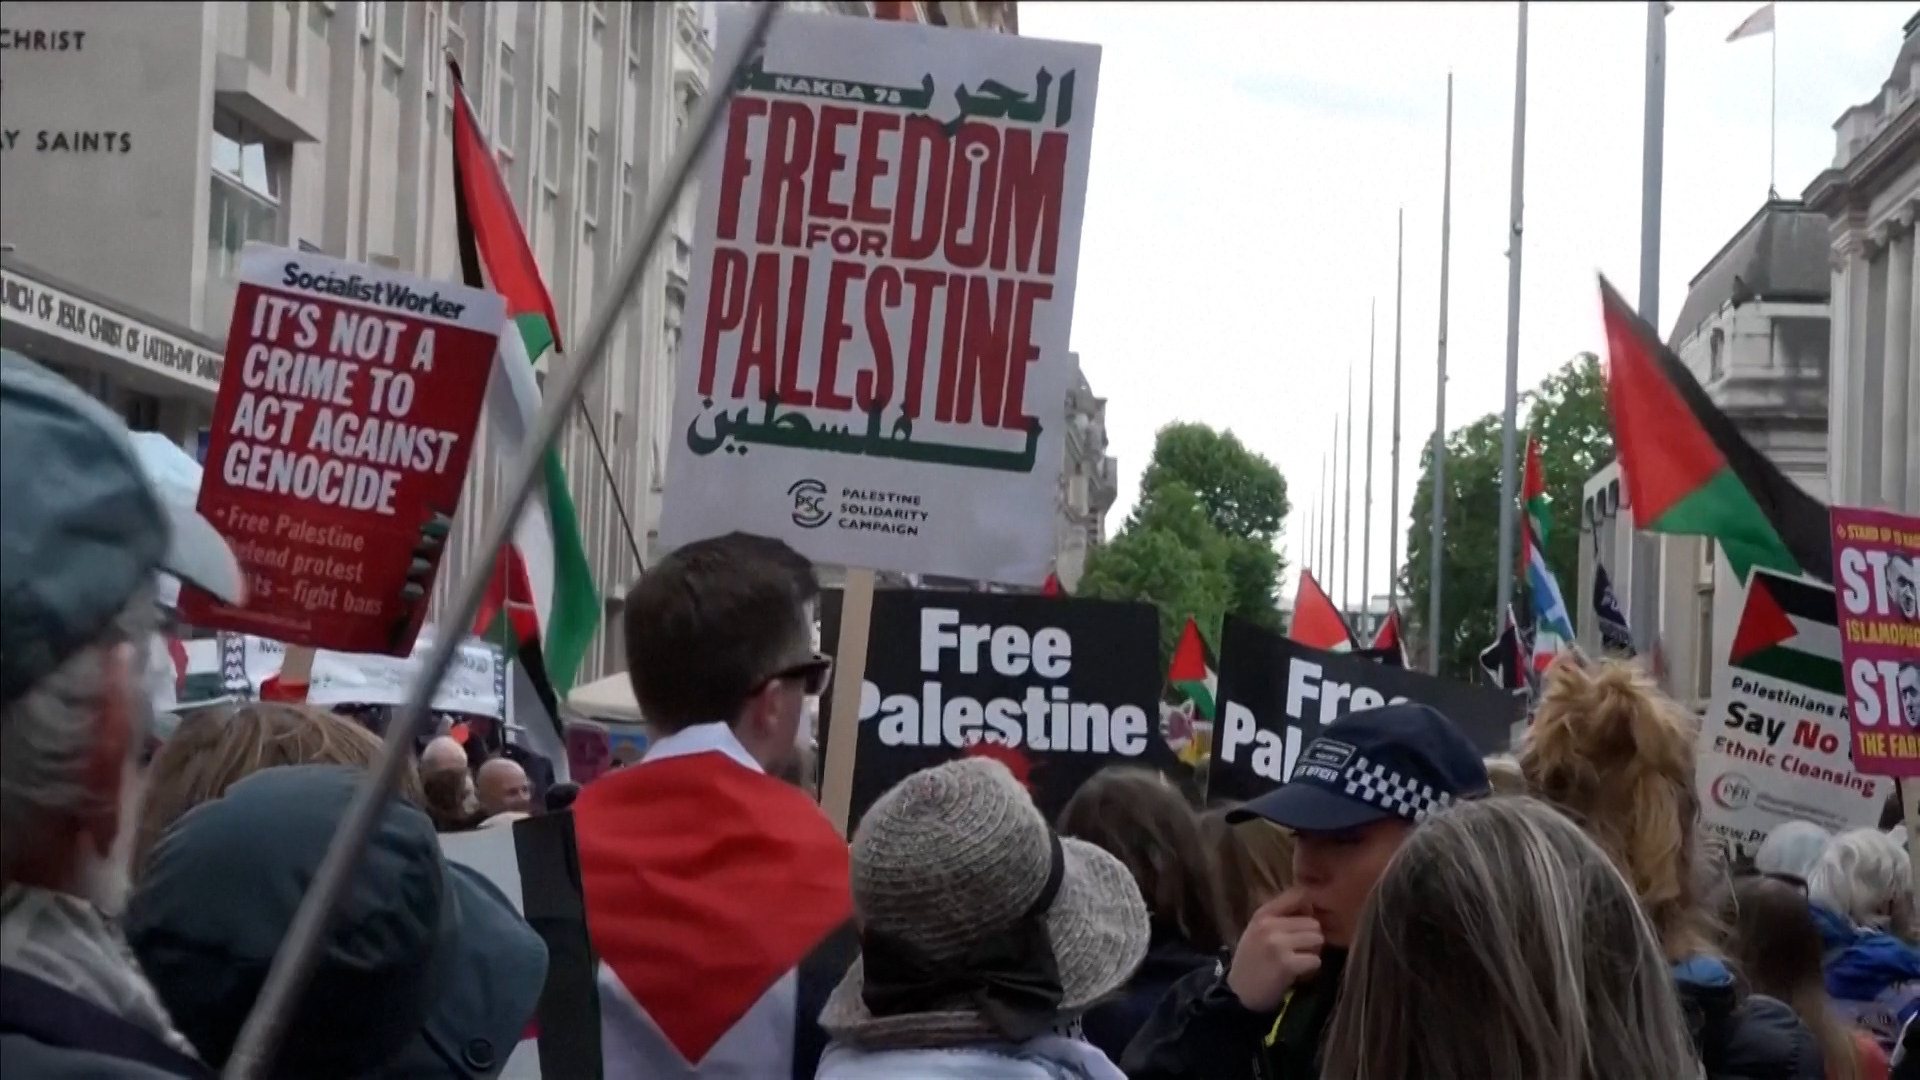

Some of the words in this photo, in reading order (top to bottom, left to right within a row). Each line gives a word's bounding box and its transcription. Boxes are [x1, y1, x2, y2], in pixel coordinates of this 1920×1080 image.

[774, 77, 866, 101] NAKBA
[36, 129, 132, 153] SAINTS
[715, 95, 1069, 277] FREEDOM
[806, 222, 889, 258] FOR
[38, 292, 53, 321] OF
[57, 300, 86, 335] JESUS
[89, 312, 124, 349] CHRIST
[127, 328, 140, 354] OF
[250, 294, 322, 349] IT'S
[329, 310, 408, 365] NOT
[410, 327, 436, 372] A
[697, 246, 1054, 430] PALESTINE
[242, 343, 359, 406] CRIME
[369, 366, 416, 418] TO
[229, 391, 304, 446] ACT
[307, 406, 459, 474] AGAINST
[223, 440, 402, 515] GENOCIDE
[841, 487, 922, 506] PALESTINE
[227, 505, 270, 535] Free
[275, 513, 365, 553] Palestine
[838, 517, 919, 536] CAMPAIGN
[840, 502, 929, 522] SOLIDARITY
[290, 554, 365, 584] protest
[343, 588, 383, 616] bans
[920, 606, 1072, 679] Free
[1286, 657, 1410, 726] Fre
[1731, 675, 1836, 717] Palestinians
[1723, 700, 1786, 746] Say
[1793, 718, 1840, 755] No
[1857, 731, 1888, 758] THE
[1712, 735, 1777, 768] Ethnic
[1780, 752, 1876, 799] Cleansing
